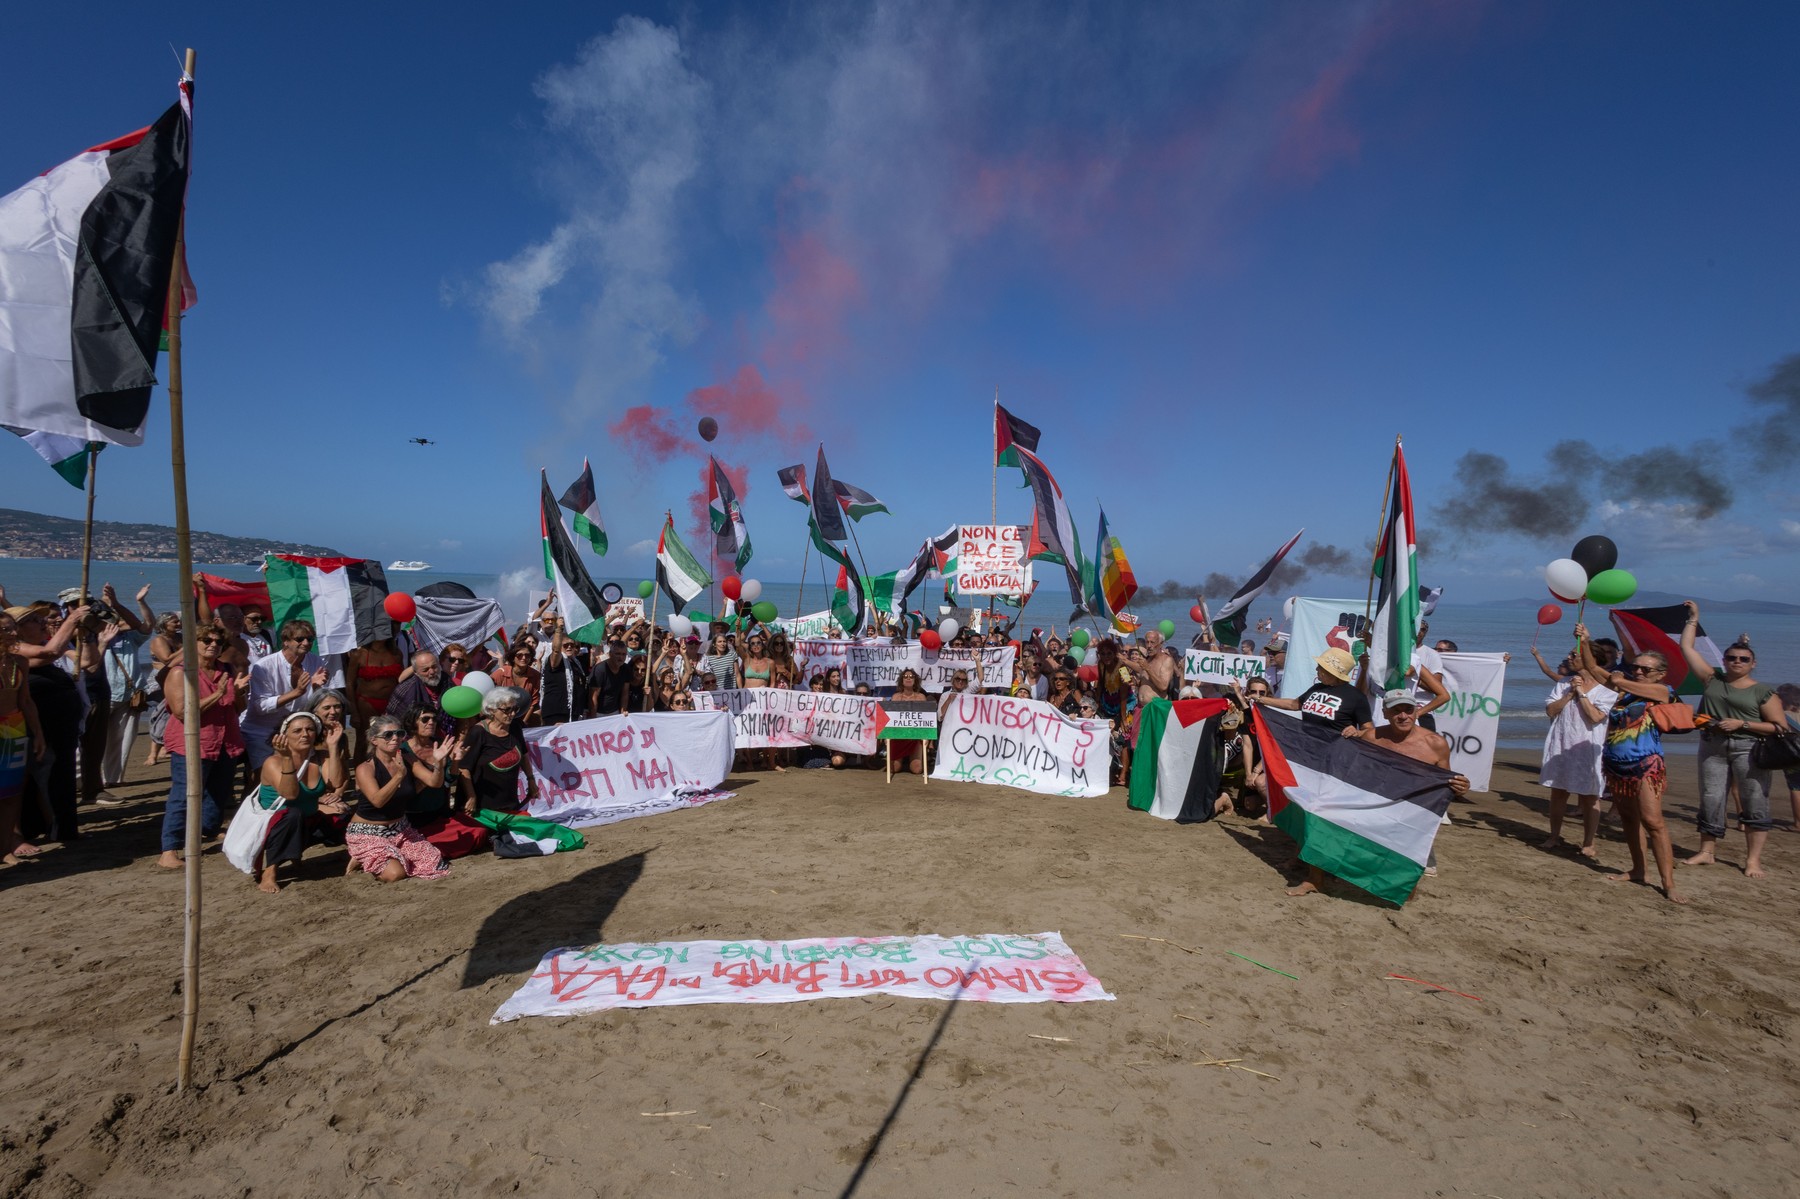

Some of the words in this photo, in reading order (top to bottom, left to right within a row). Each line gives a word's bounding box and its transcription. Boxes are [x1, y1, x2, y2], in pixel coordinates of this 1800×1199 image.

[962, 527, 996, 541] NON
[963, 541, 1017, 559] PACE
[974, 561, 1020, 573] SENZA
[960, 573, 1022, 591] GIUSTIZIA
[921, 666, 932, 681] LA
[701, 690, 778, 712] FERMIAMO
[784, 691, 793, 713] IL
[797, 693, 876, 718] GENOCIDIO
[1303, 701, 1333, 718] GAZA
[893, 719, 935, 727] PALESTINE
[899, 711, 923, 720] FREE
[959, 695, 1062, 743] UNISCITI
[640, 727, 656, 749] DI
[952, 727, 1060, 779] CONDIVIDI
[713, 941, 918, 964] BOMBING
[938, 937, 1049, 962] STOP
[531, 954, 667, 1003] GAZA
[923, 966, 1085, 994] SIAMO
